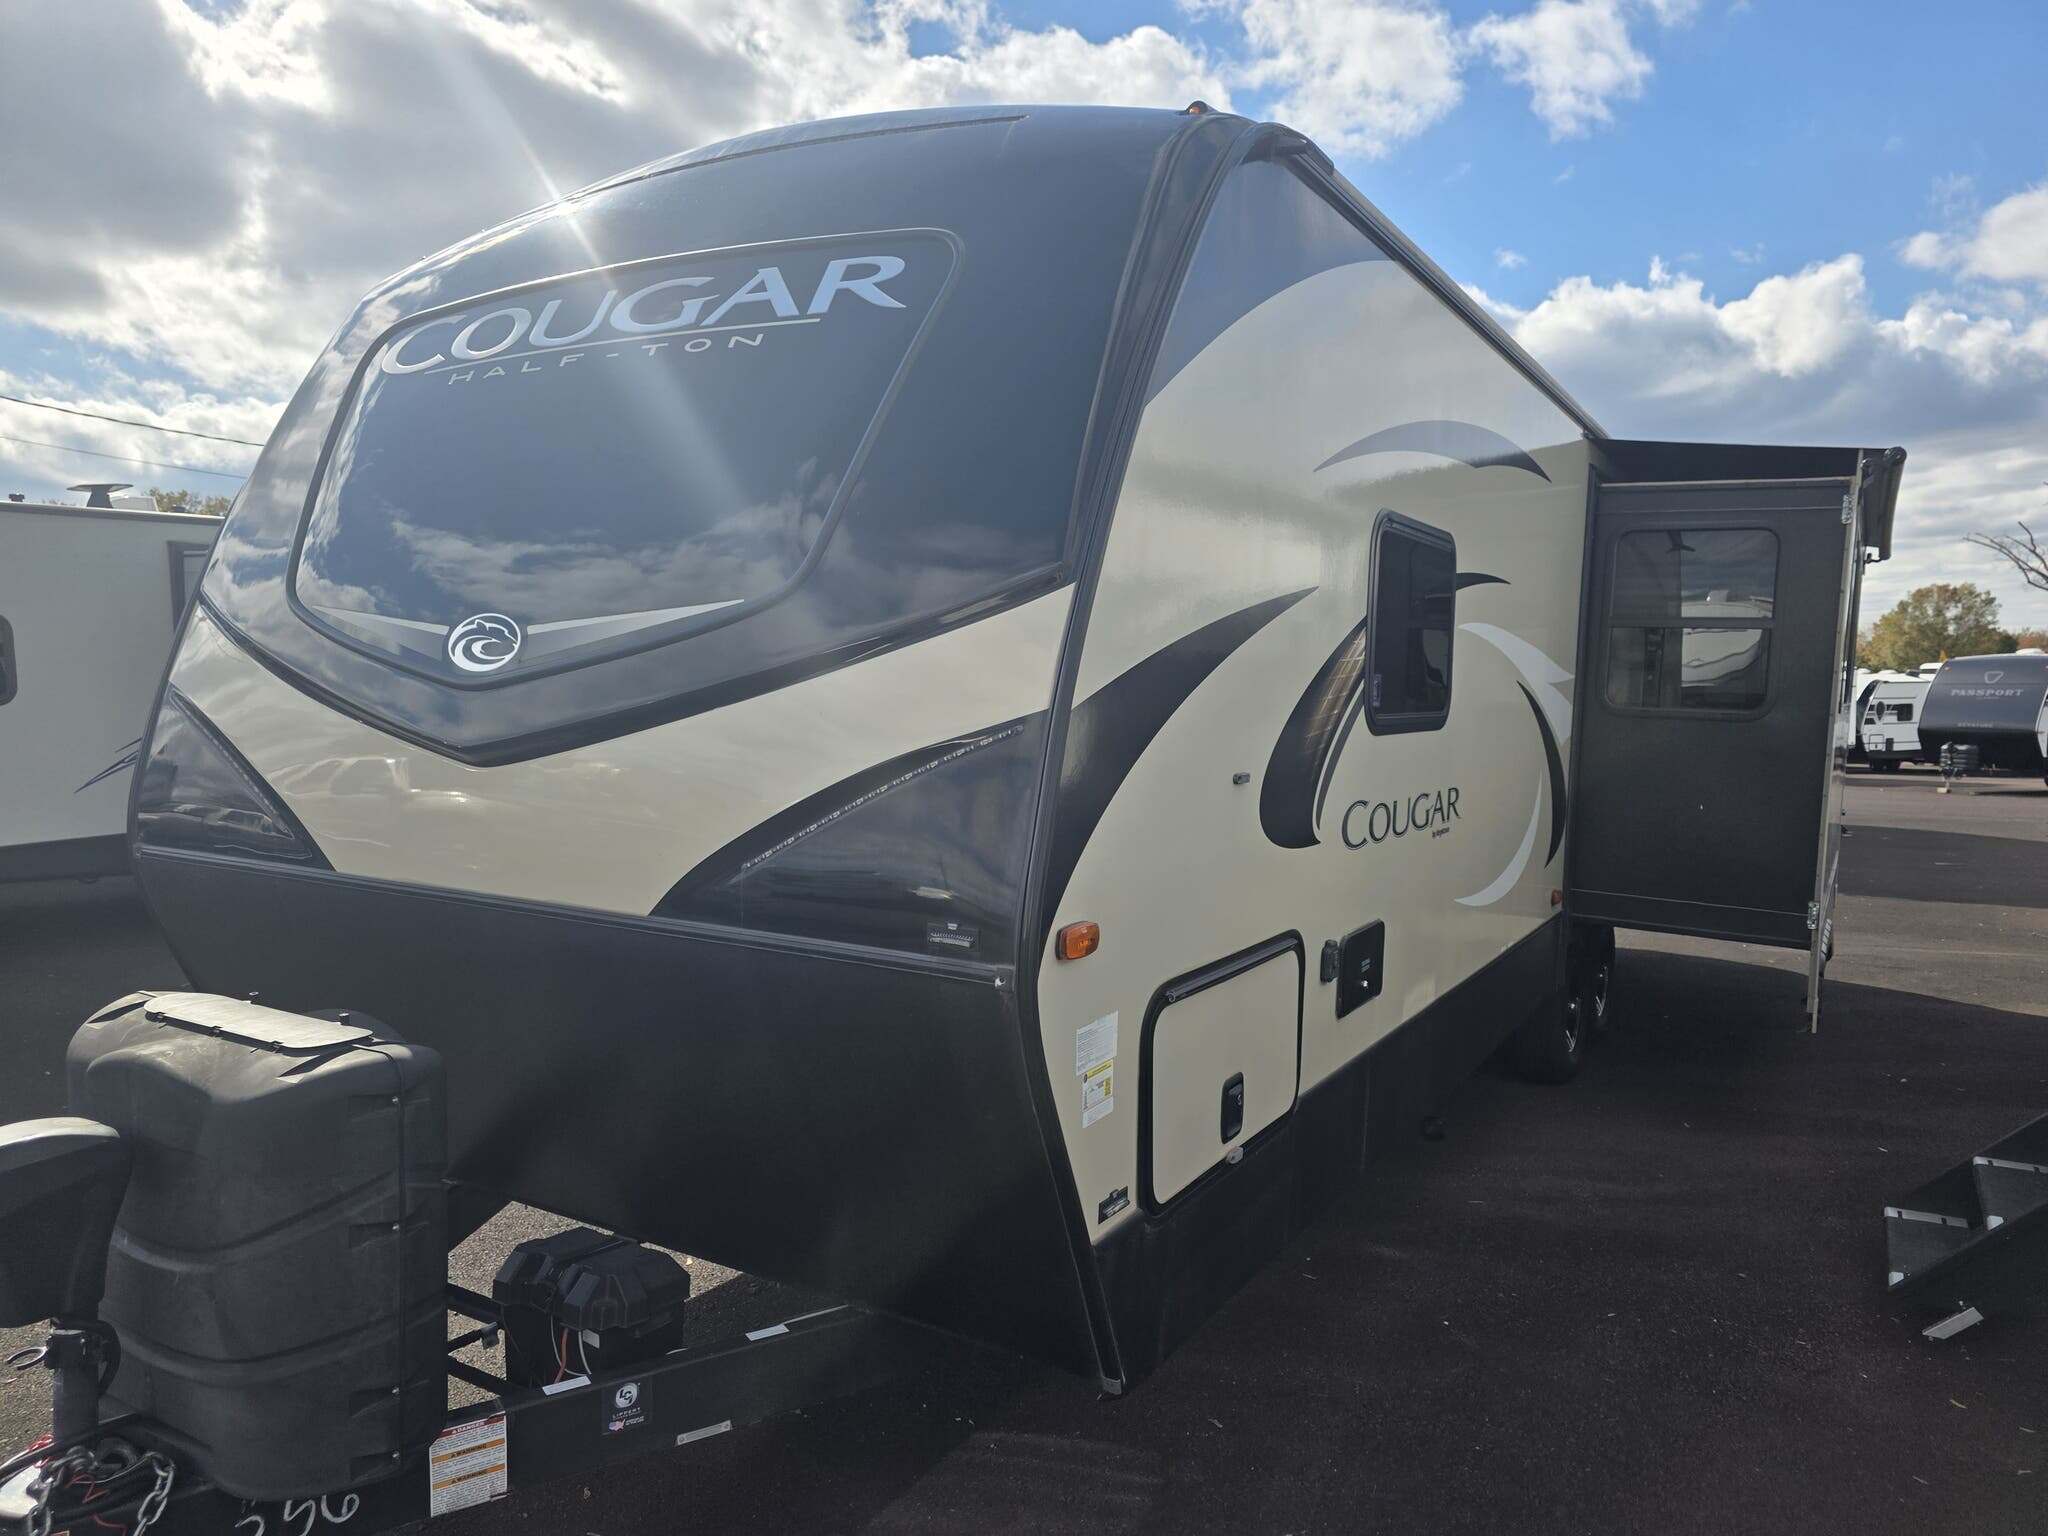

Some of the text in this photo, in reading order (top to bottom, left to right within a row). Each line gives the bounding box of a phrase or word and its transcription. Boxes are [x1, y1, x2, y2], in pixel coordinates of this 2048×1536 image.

[381, 255, 907, 375] COUGAR
[1951, 688, 2024, 697] PASSPORT
[1342, 787, 1461, 850] COUGAR
[457, 1421, 486, 1433] DANGER
